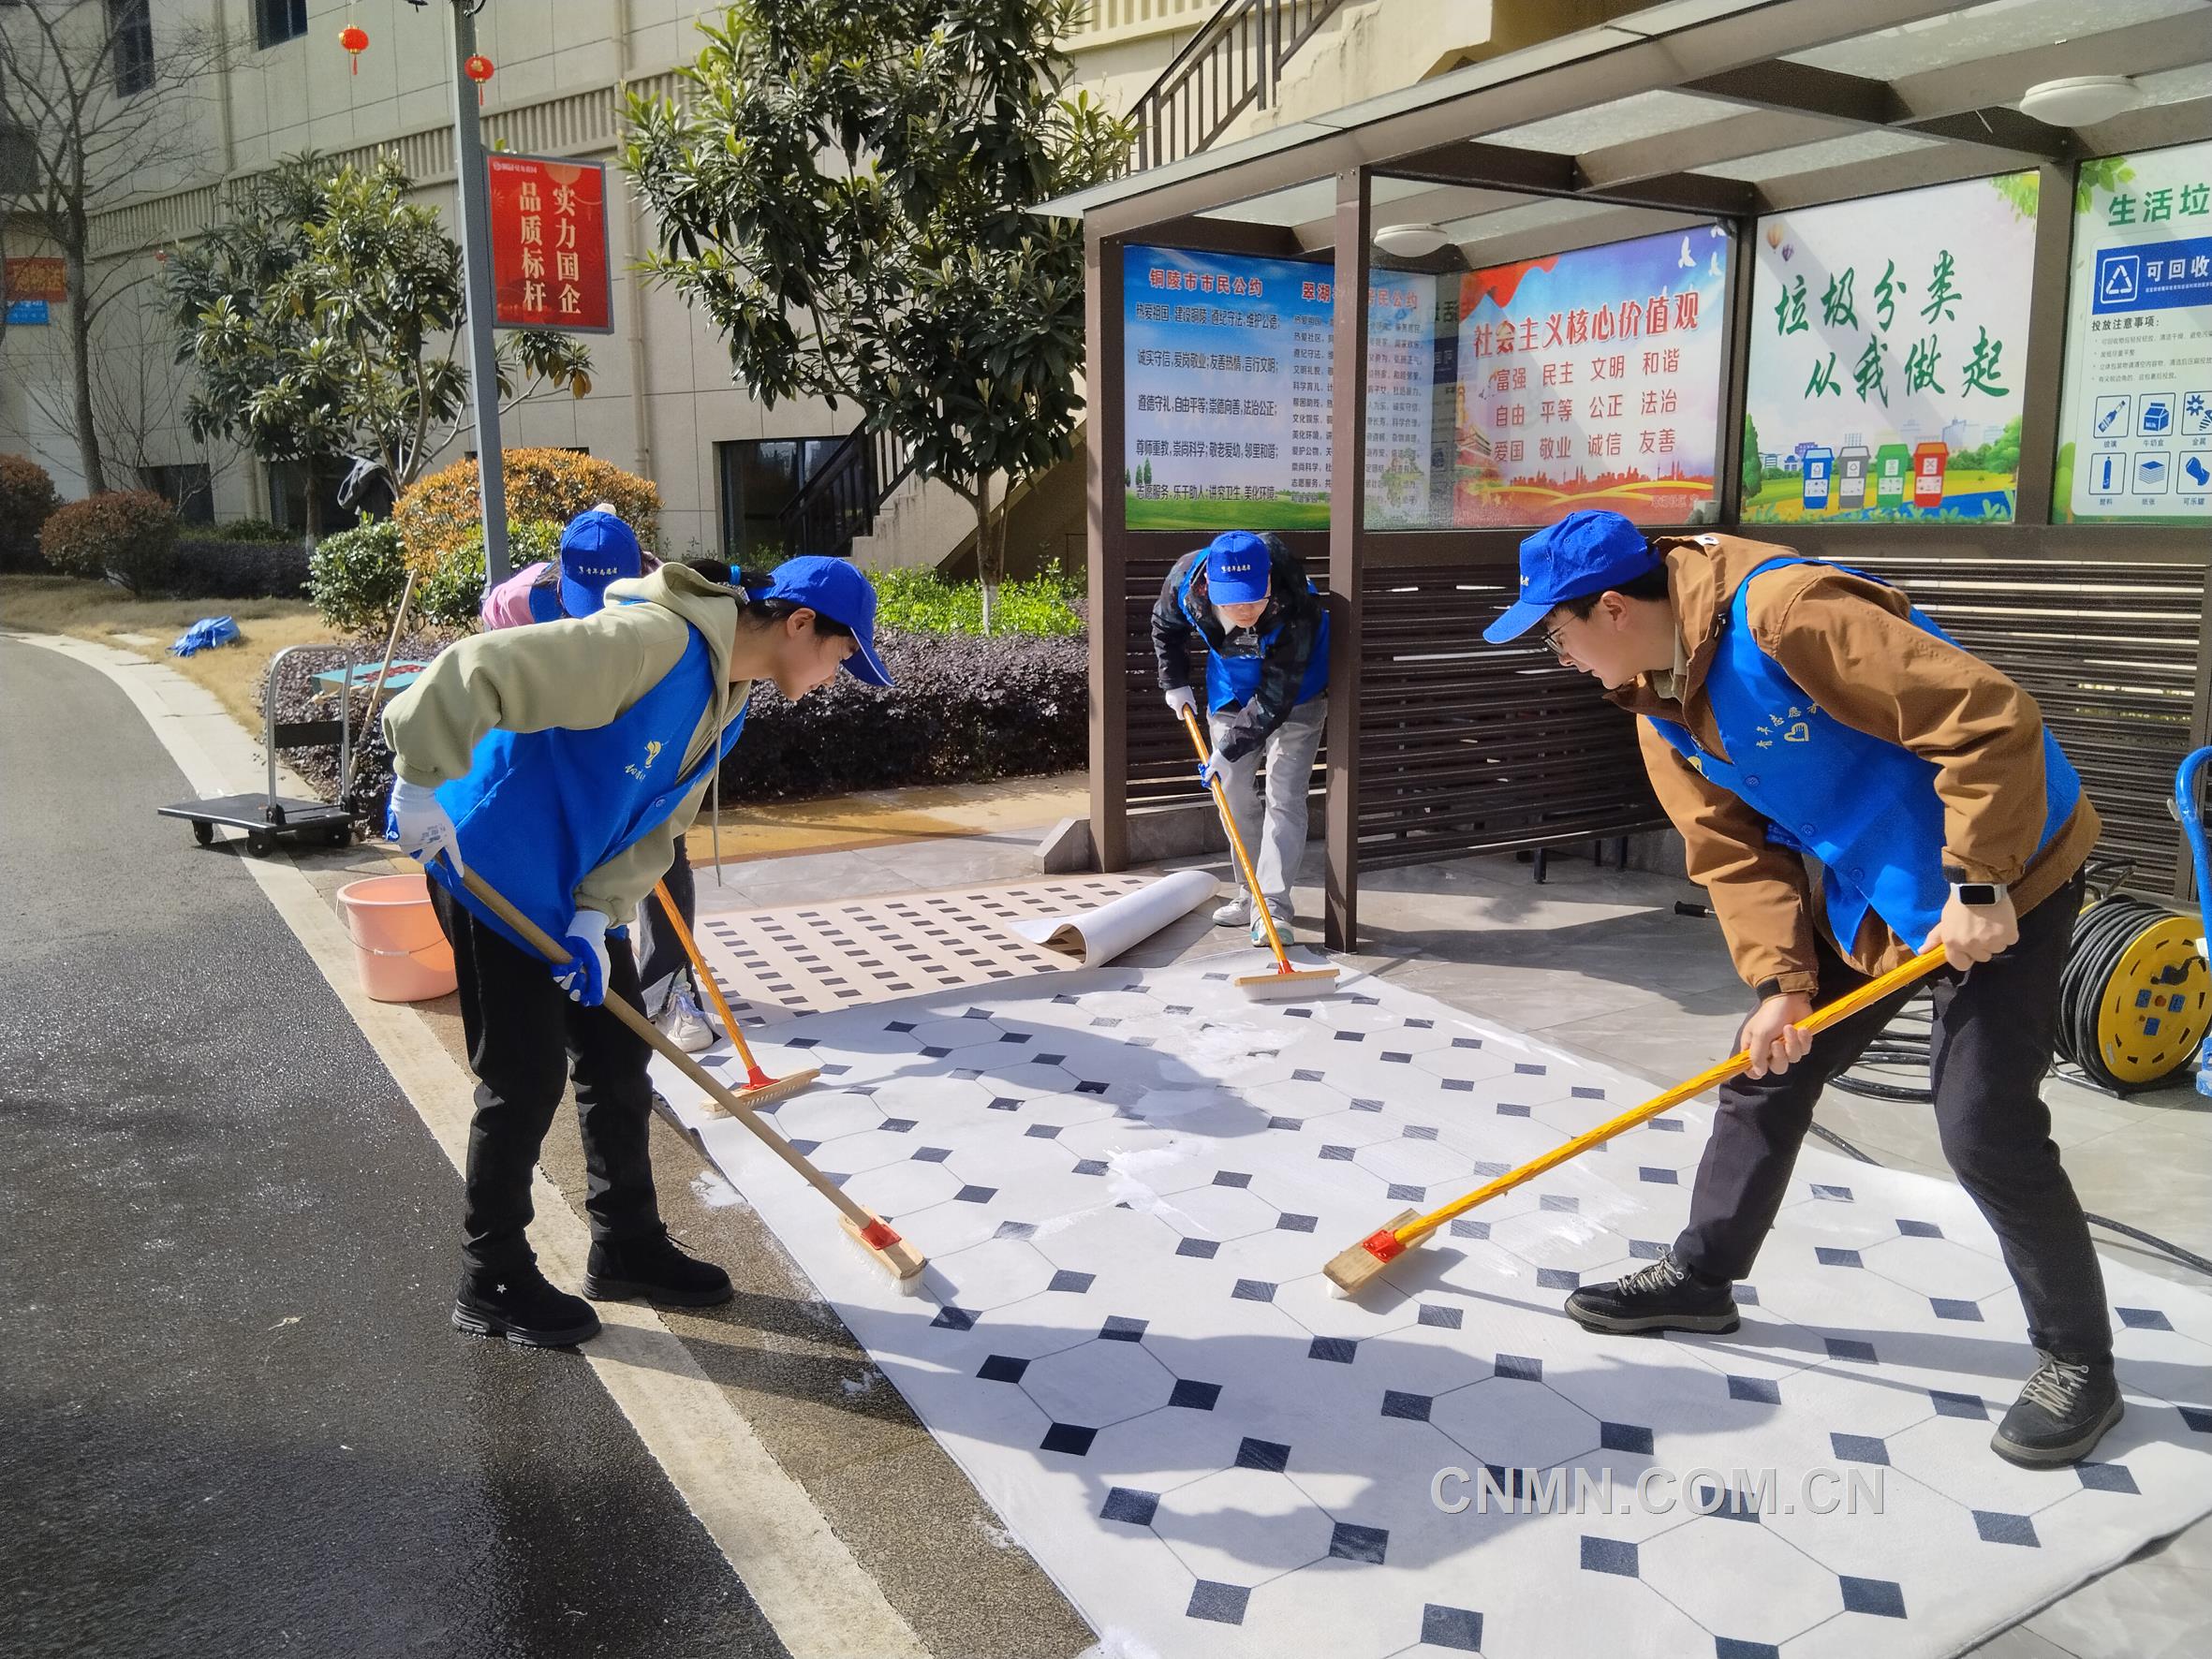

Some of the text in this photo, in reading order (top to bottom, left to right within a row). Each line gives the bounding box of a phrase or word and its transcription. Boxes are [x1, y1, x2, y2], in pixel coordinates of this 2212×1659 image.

[2108, 183, 2211, 227] 生活垃
[520, 181, 547, 312] 品质标杆
[553, 184, 582, 315] 实力国企
[1149, 268, 1263, 297] 铜陵市市民公约
[2146, 255, 2210, 283] 可回收
[1774, 249, 1963, 336] 垃圾分类
[1473, 292, 1700, 360] 社会主义核心价值观
[1496, 348, 1680, 392] 富强 民主 文明 和谐
[1805, 325, 2010, 408] 从我做起
[1496, 389, 1677, 428] 自由 平等 公正 法治
[1494, 428, 1675, 462] 爱国 敬业 诚信 友善
